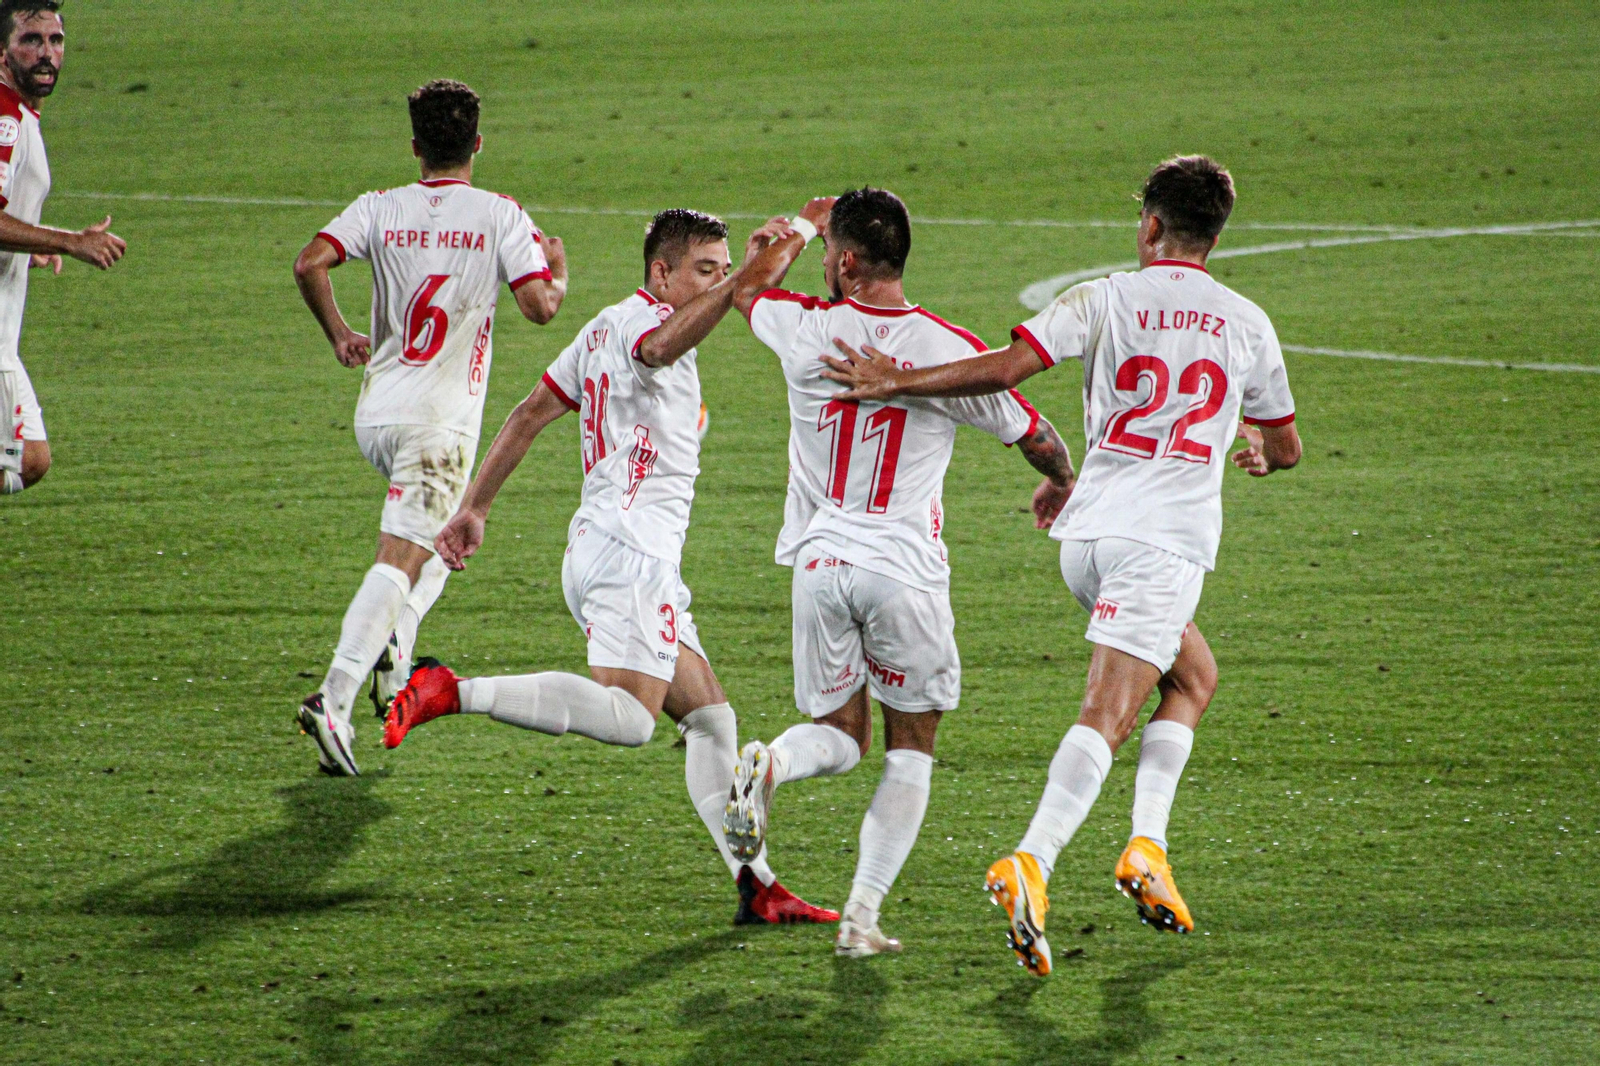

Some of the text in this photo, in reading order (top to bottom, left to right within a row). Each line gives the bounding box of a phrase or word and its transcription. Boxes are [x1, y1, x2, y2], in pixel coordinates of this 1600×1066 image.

[384, 229, 486, 252] PEPE MENA
[398, 274, 451, 367] 6
[1136, 310, 1226, 338] V.LOPEZ
[1098, 355, 1229, 465] 22
[817, 398, 908, 514] 11
[658, 603, 679, 646] 3
